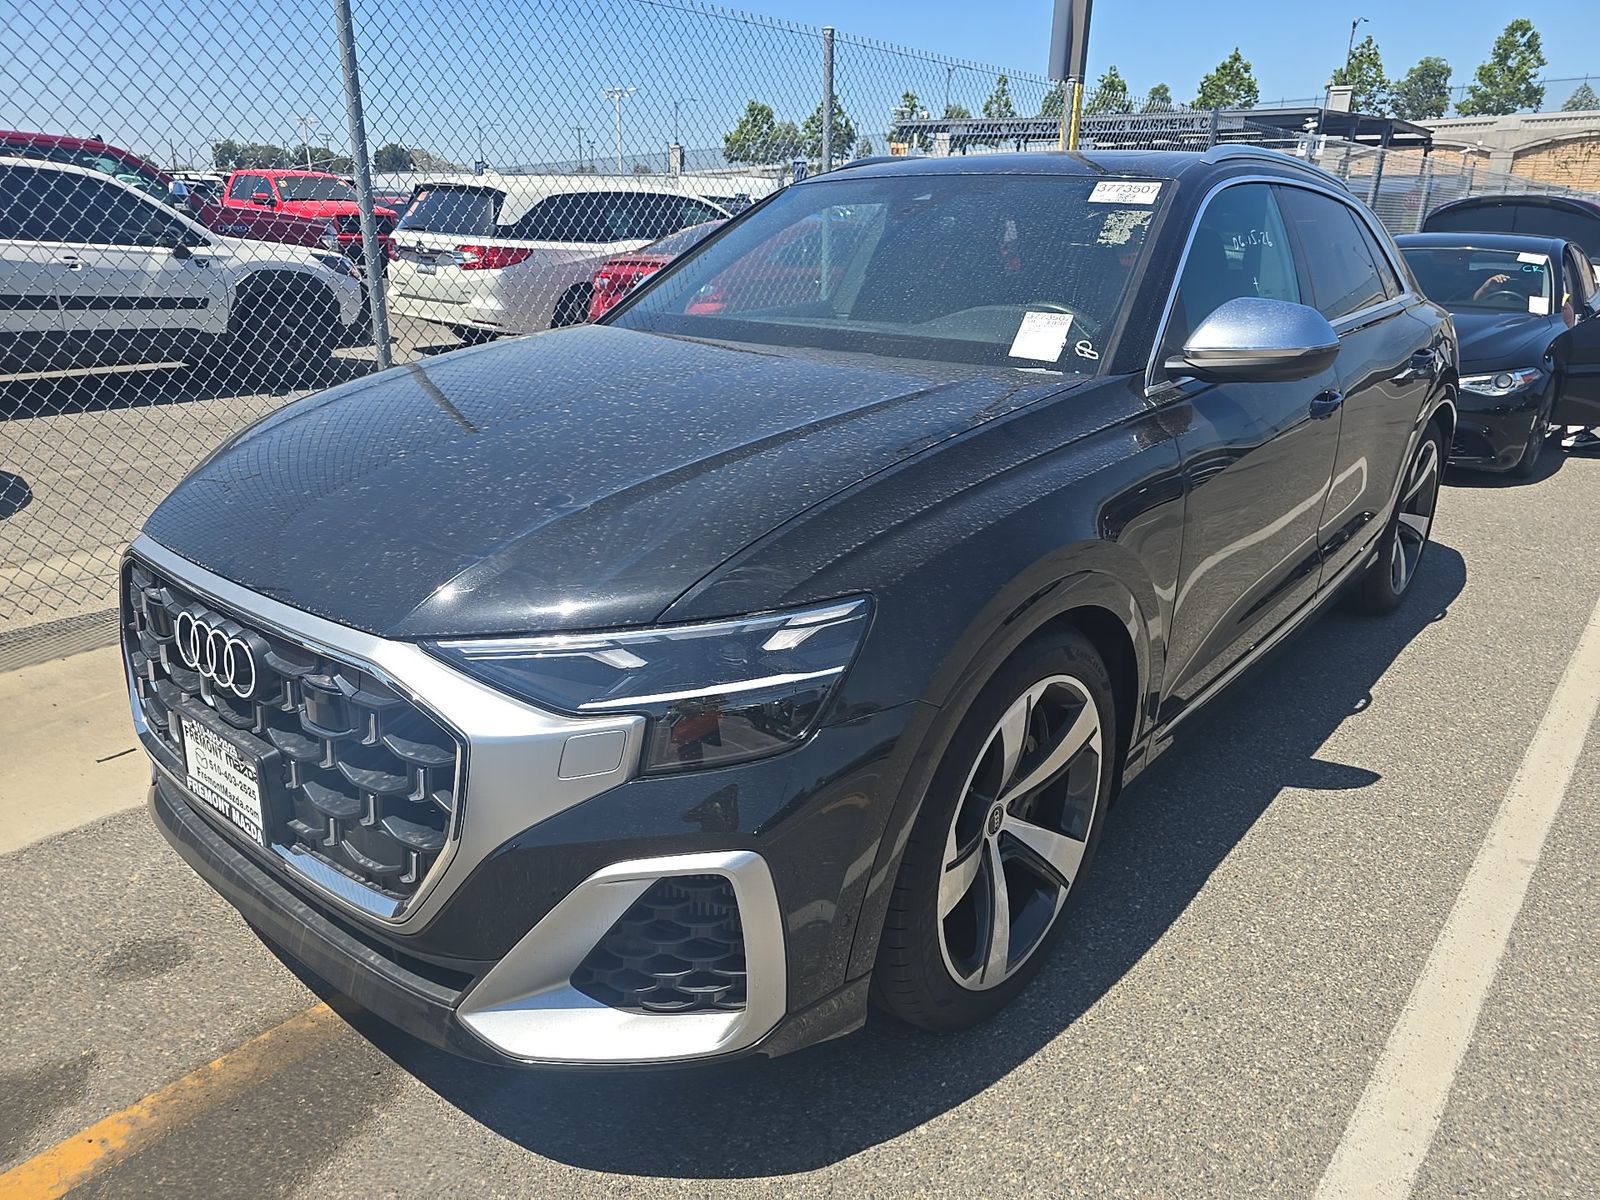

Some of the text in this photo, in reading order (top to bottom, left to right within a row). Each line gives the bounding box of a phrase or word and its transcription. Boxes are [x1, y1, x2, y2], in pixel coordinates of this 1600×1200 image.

[965, 122, 1002, 133] THANK
[1006, 122, 1029, 132] YOU
[1031, 121, 1058, 132] FOR
[1130, 119, 1195, 130] MANHEIM
[1097, 183, 1160, 194] 3773507
[183, 724, 223, 761] FREMONT
[186, 776, 264, 848] FREMONT MAZDA
[196, 766, 260, 821] FremontMazda.com
